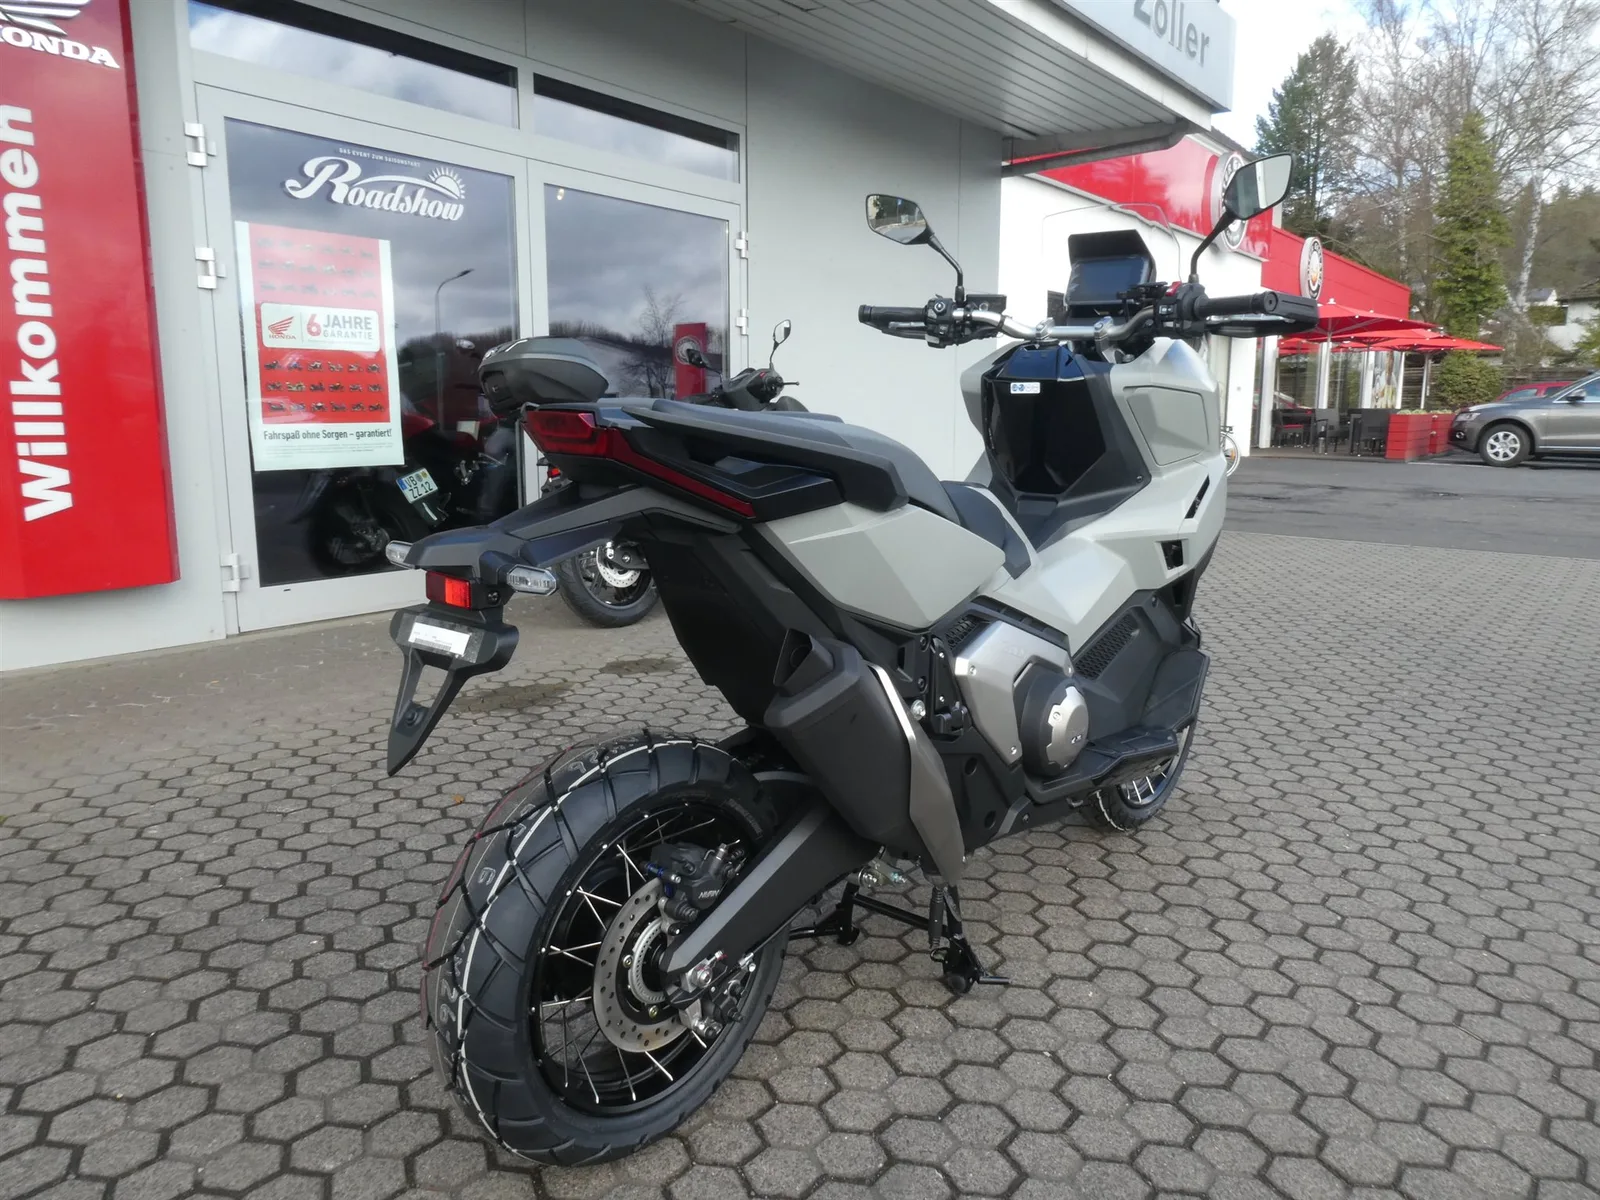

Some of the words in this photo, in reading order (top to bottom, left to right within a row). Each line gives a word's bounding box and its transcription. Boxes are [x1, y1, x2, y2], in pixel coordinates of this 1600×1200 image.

[0, 25, 120, 69] ONDA
[352, 150, 370, 158] EVENT
[372, 153, 384, 161] ZUM
[384, 155, 421, 168] SAISONSTART
[285, 156, 464, 221] Roadshow
[0, 104, 72, 521] Willkommen
[306, 313, 322, 337] 6
[323, 315, 373, 330] JAHRE
[323, 329, 373, 340] GARANTIE
[263, 430, 300, 441] Fahrspaß
[302, 430, 320, 439] ohne
[322, 429, 348, 440] Sorgen
[355, 428, 392, 440] garantiert!
[405, 475, 418, 488] VB
[409, 486, 423, 499] ZZ
[421, 481, 434, 493] 12
